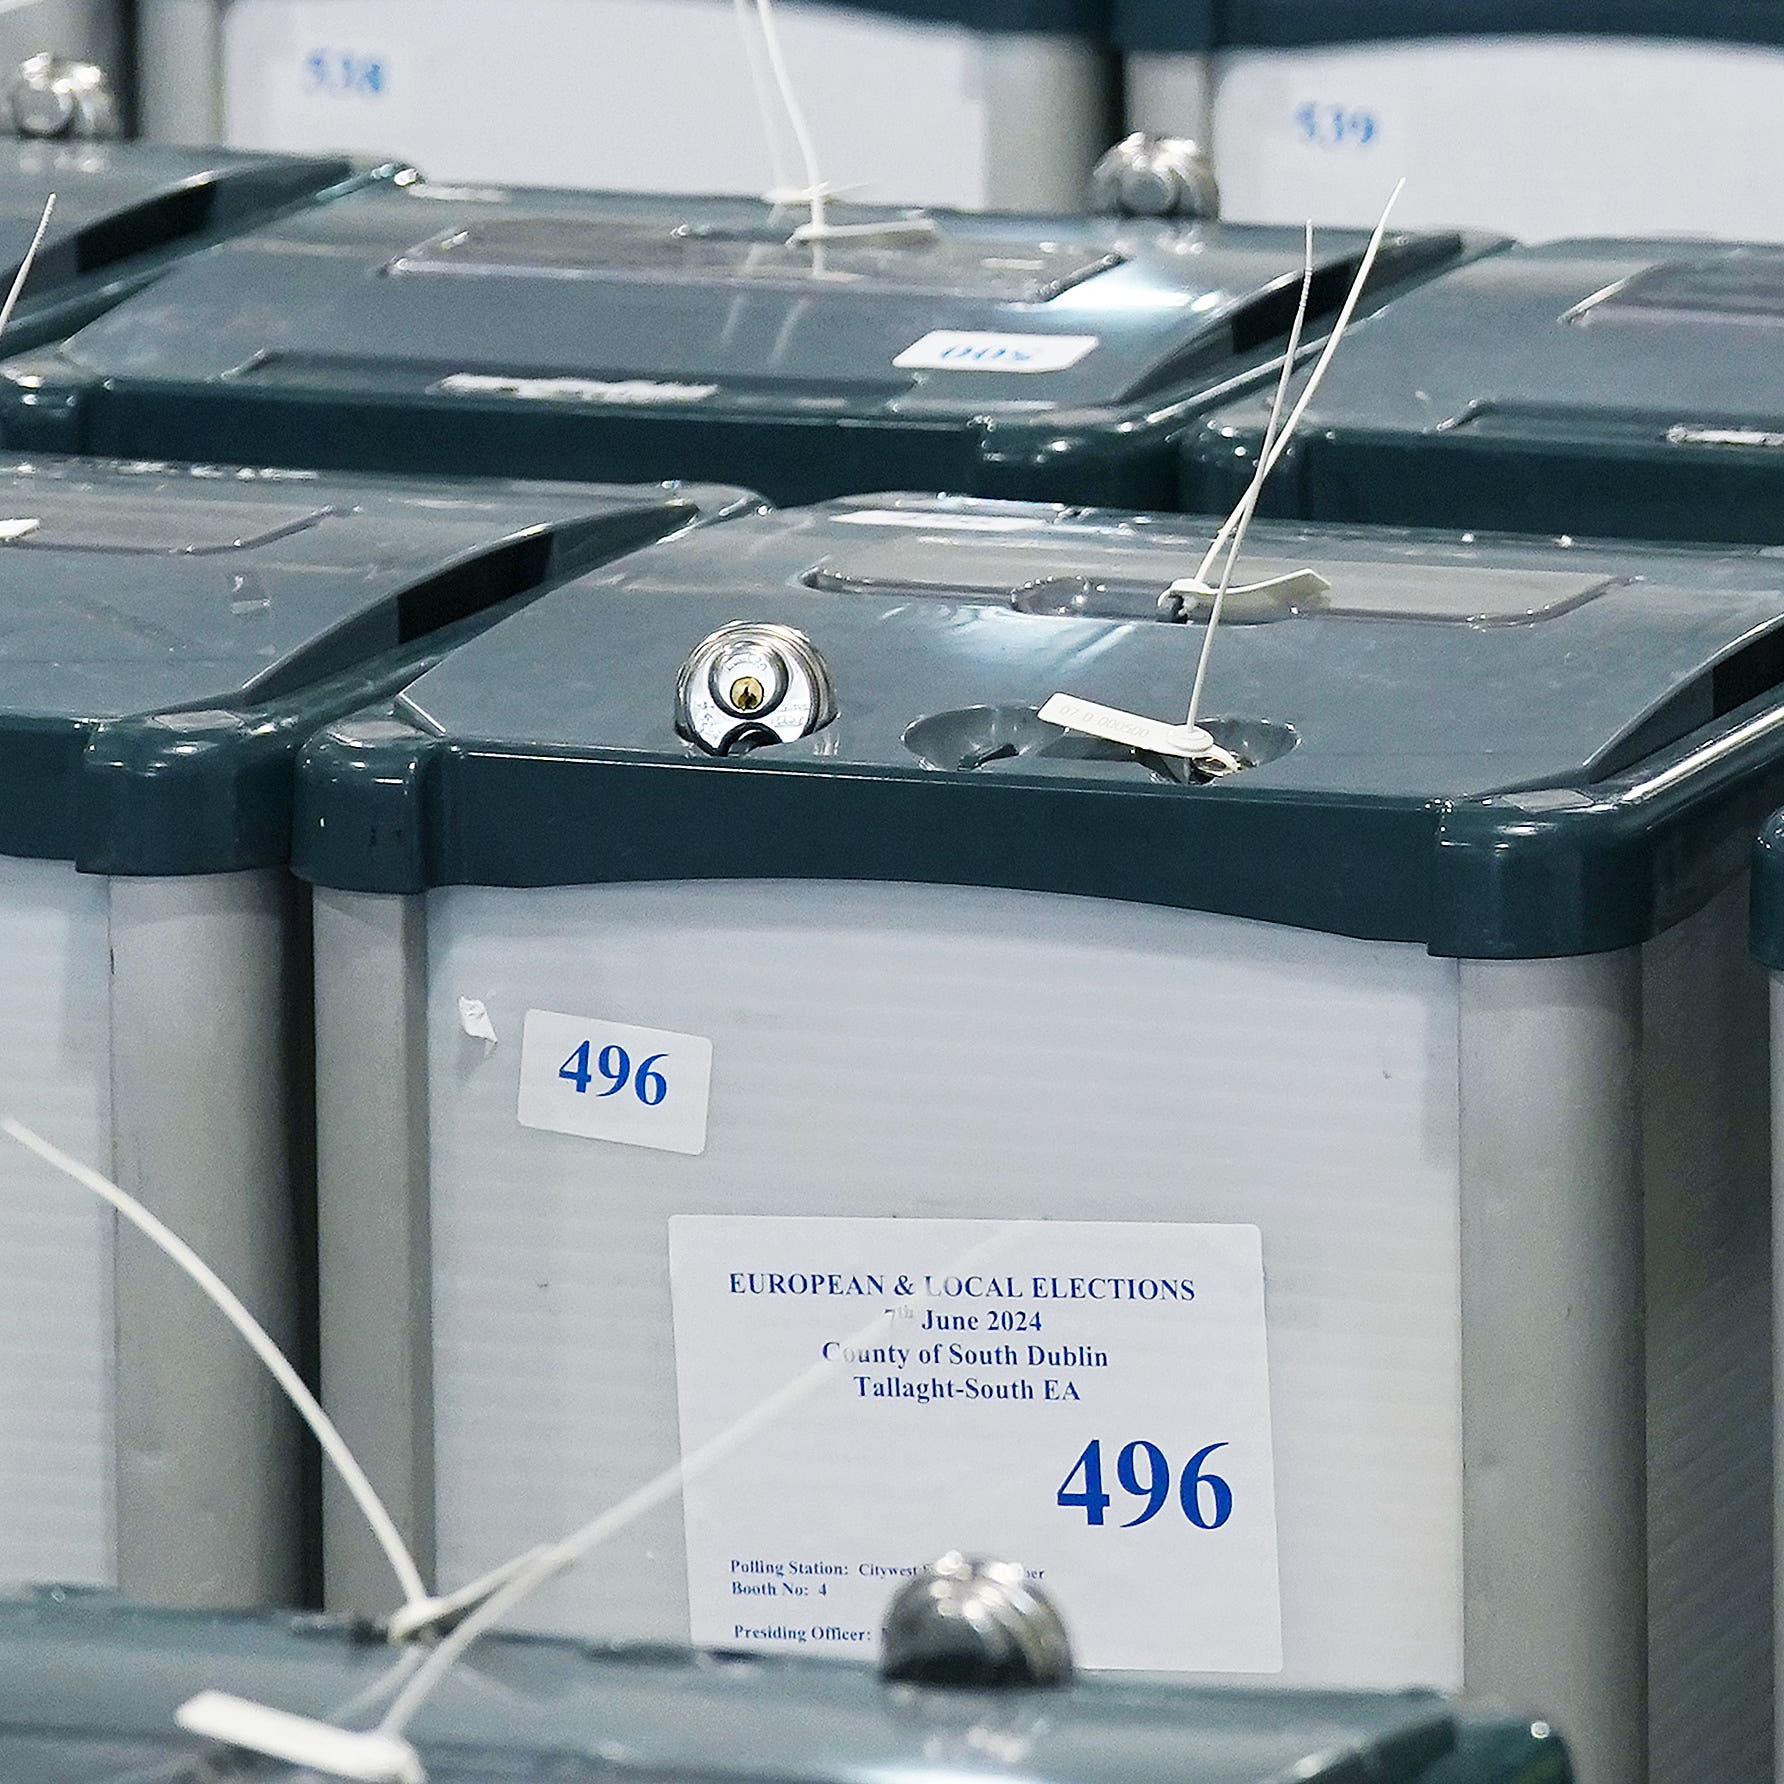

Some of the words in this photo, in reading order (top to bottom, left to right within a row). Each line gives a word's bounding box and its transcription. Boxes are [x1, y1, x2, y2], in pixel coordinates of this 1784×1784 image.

[306, 51, 386, 95] 538
[1296, 103, 1377, 145] 539
[559, 1040, 668, 1105] 496
[730, 1273, 883, 1295] EUROPEAN
[894, 1275, 913, 1295] &
[925, 1276, 1022, 1297] LOCAL
[1033, 1278, 1194, 1300] ELECTIONS
[922, 1310, 978, 1330] June
[987, 1311, 1041, 1331] 2024
[823, 1342, 909, 1369] County
[919, 1344, 942, 1364] of
[949, 1343, 1017, 1365] South
[1028, 1346, 1107, 1366] Dublin
[853, 1377, 1033, 1403] Tallaght-South
[1045, 1380, 1080, 1400] EA
[1057, 1440, 1232, 1529] 496
[732, 1560, 784, 1576] Polling
[789, 1561, 848, 1575] Station:
[859, 1563, 917, 1579] Citywest
[733, 1582, 776, 1595] Booth
[783, 1583, 808, 1596] No:
[819, 1583, 826, 1596] 4
[735, 1625, 806, 1642] Presiding
[812, 1627, 870, 1641] Officer:
